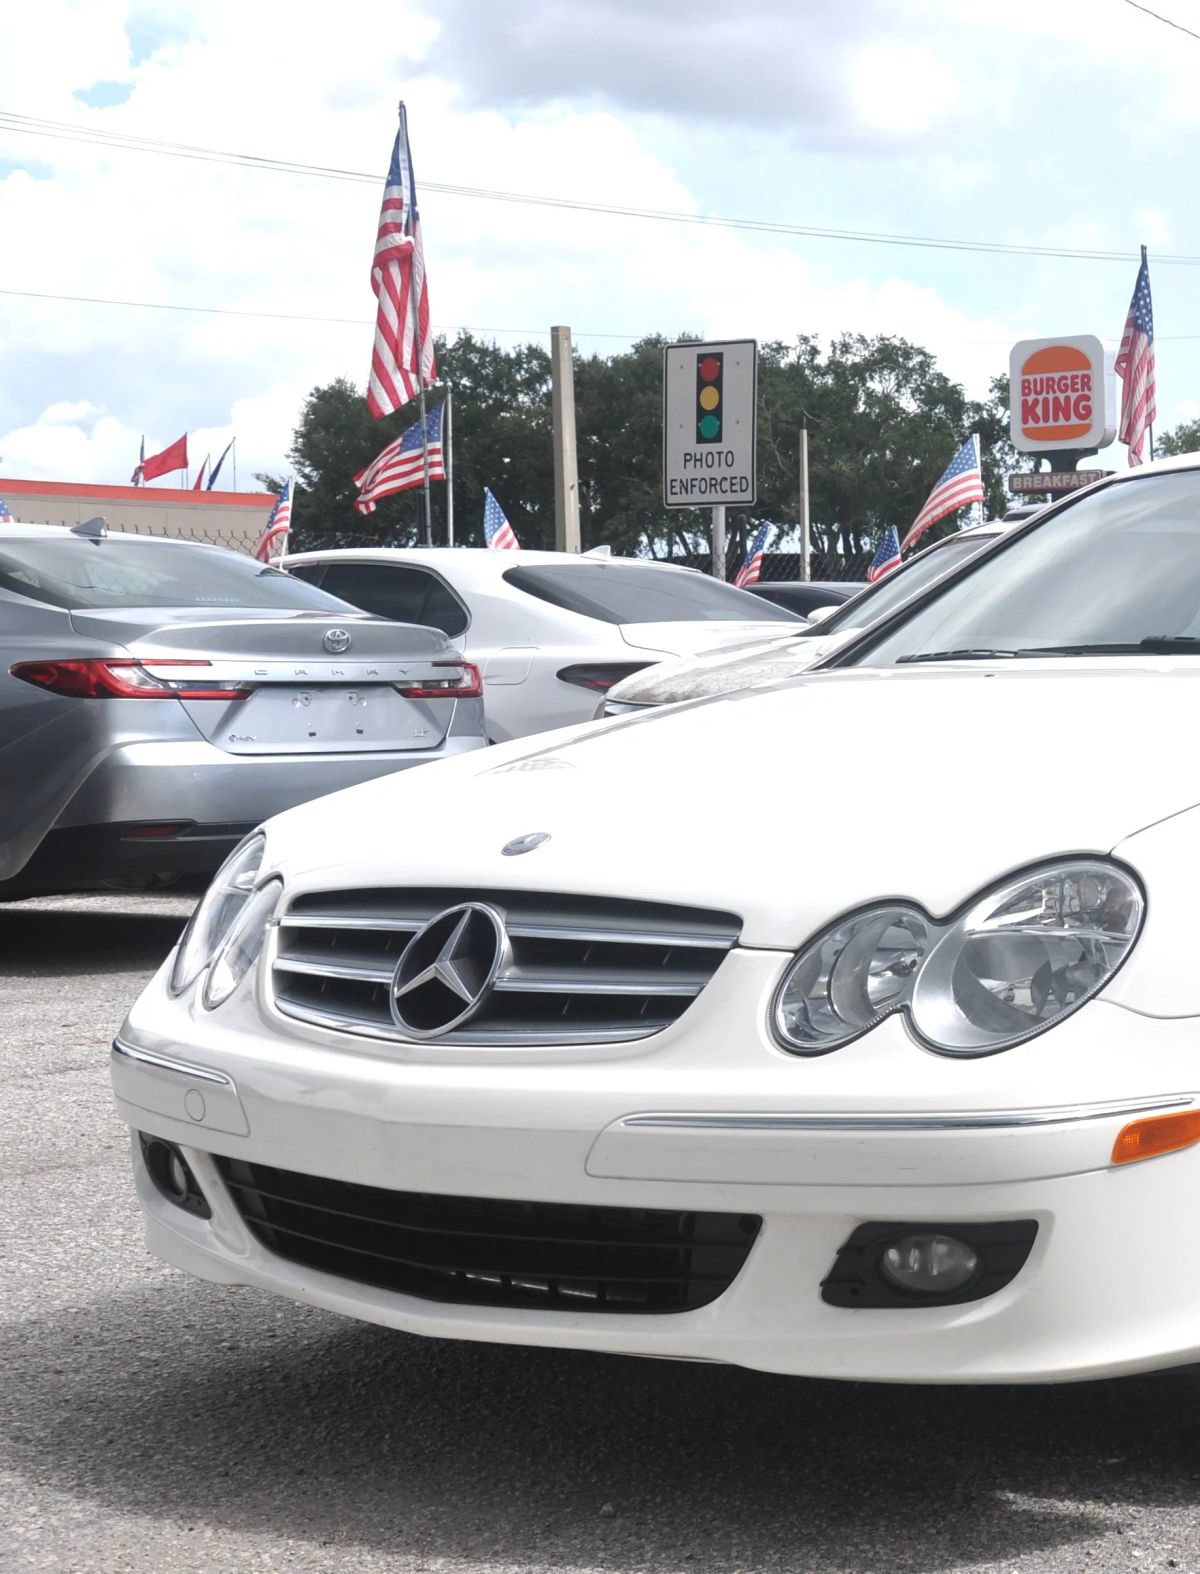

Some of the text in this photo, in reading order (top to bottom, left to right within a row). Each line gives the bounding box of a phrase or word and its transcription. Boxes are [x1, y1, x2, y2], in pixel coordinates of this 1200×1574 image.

[1021, 373, 1092, 397] BURGER
[1021, 393, 1093, 425] KING
[683, 450, 735, 469] PHOTO
[669, 476, 749, 495] ENFORCED
[1012, 473, 1097, 489] BREAKFAST
